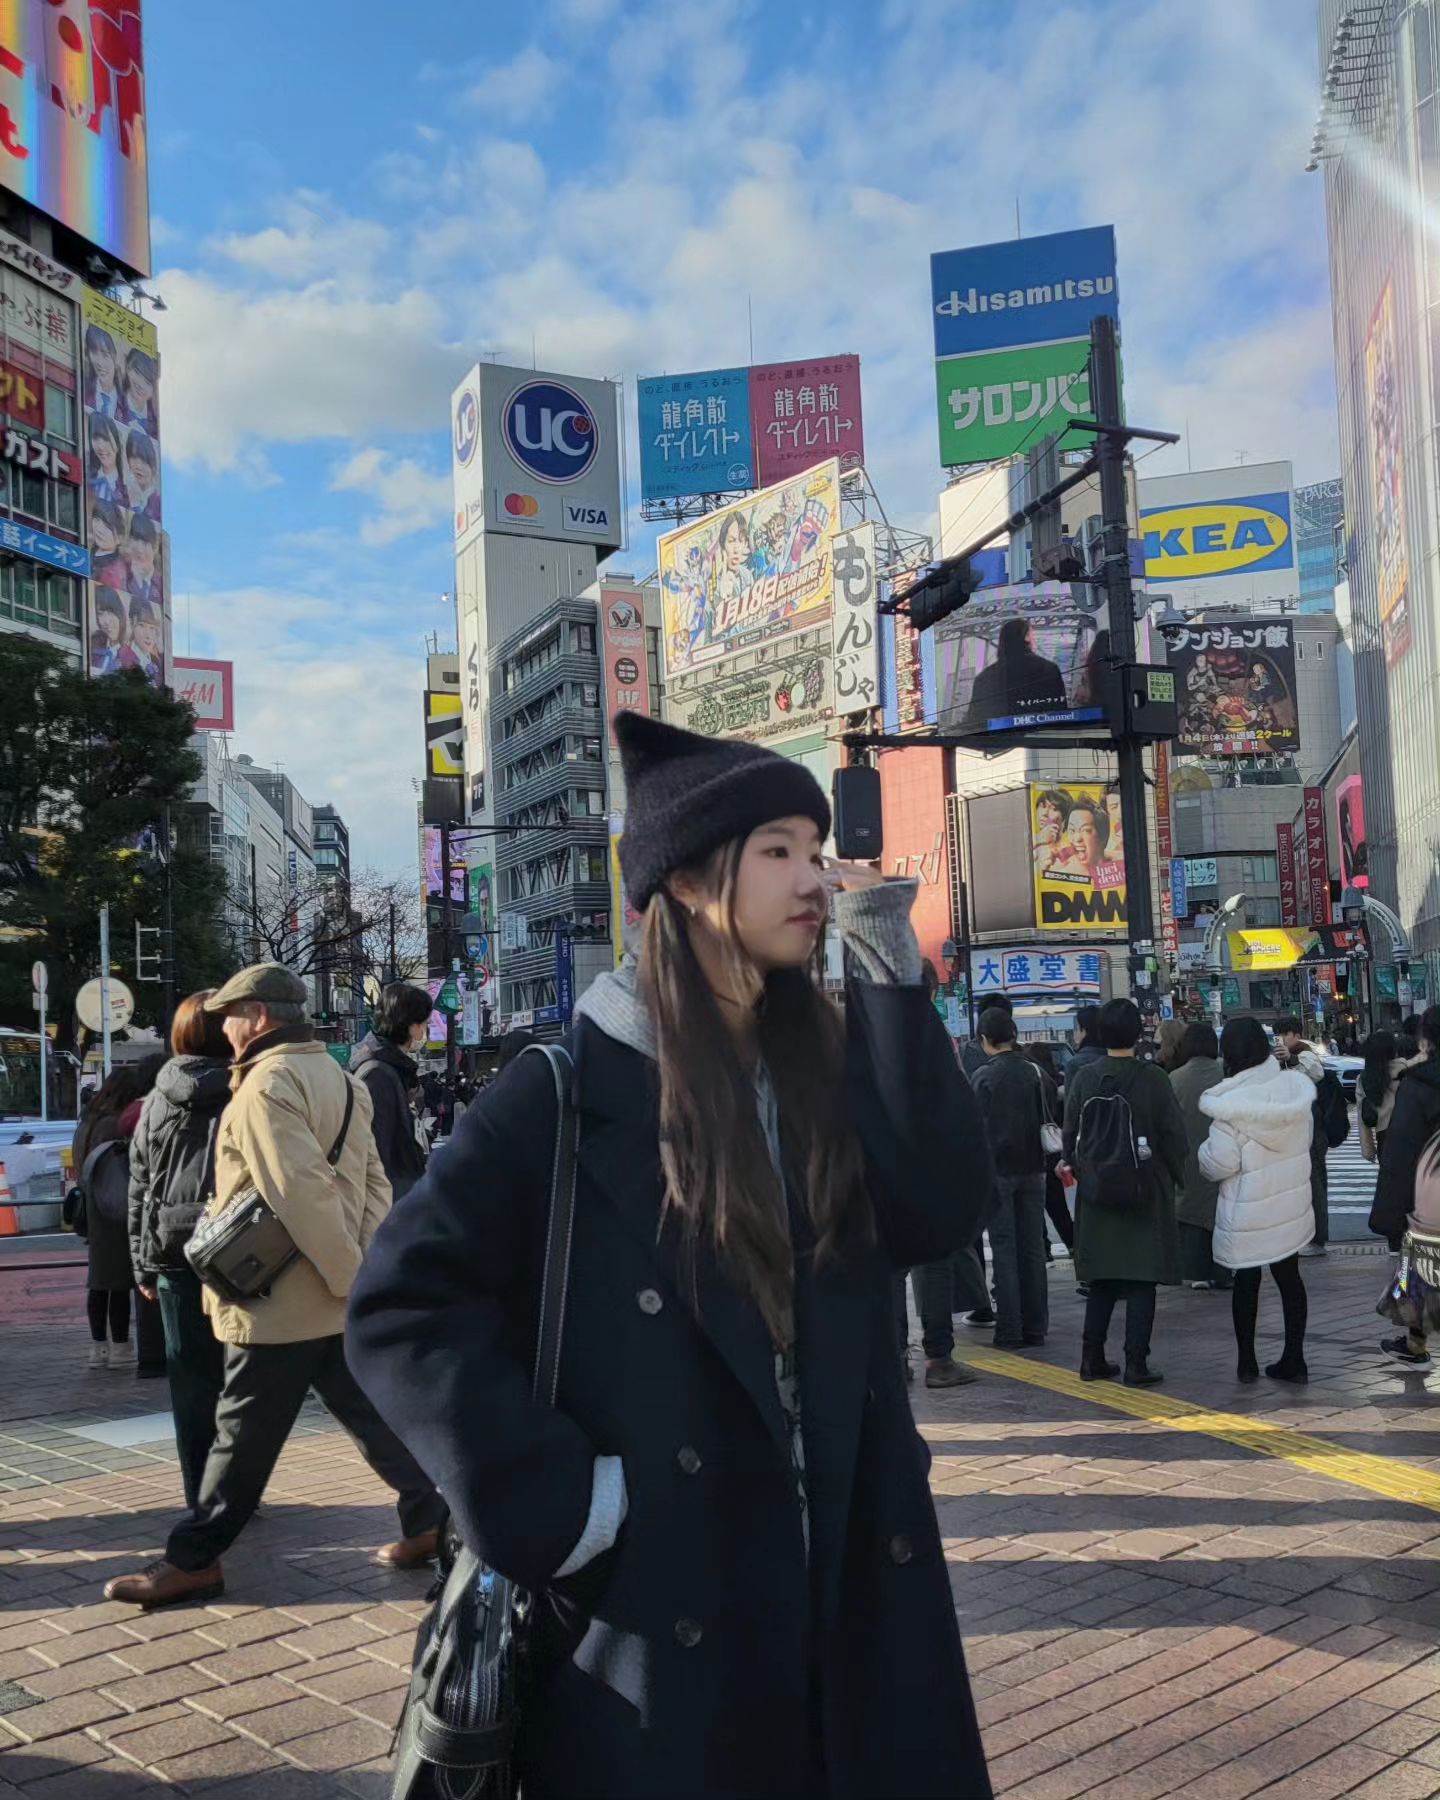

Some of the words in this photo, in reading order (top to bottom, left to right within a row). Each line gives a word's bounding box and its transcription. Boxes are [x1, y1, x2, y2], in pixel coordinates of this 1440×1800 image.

[936, 277, 1113, 316] Hisamitsu
[661, 395, 727, 430] 龍角散
[774, 383, 839, 418] 龍角散
[948, 372, 1091, 430] サロンパ
[514, 404, 589, 456] UC
[5, 430, 70, 478] ガスト
[568, 506, 608, 526] VISA
[2, 523, 86, 568] 話イーオン
[1143, 518, 1276, 559] KEA
[833, 534, 874, 704] もんじゃ
[1013, 714, 1036, 726] DHC
[1036, 710, 1075, 723] Channel
[473, 782, 483, 800] 7F
[1306, 797, 1324, 870] カラオケ
[1282, 881, 1296, 926] カラオ
[979, 954, 1099, 985] 大盛堂書
